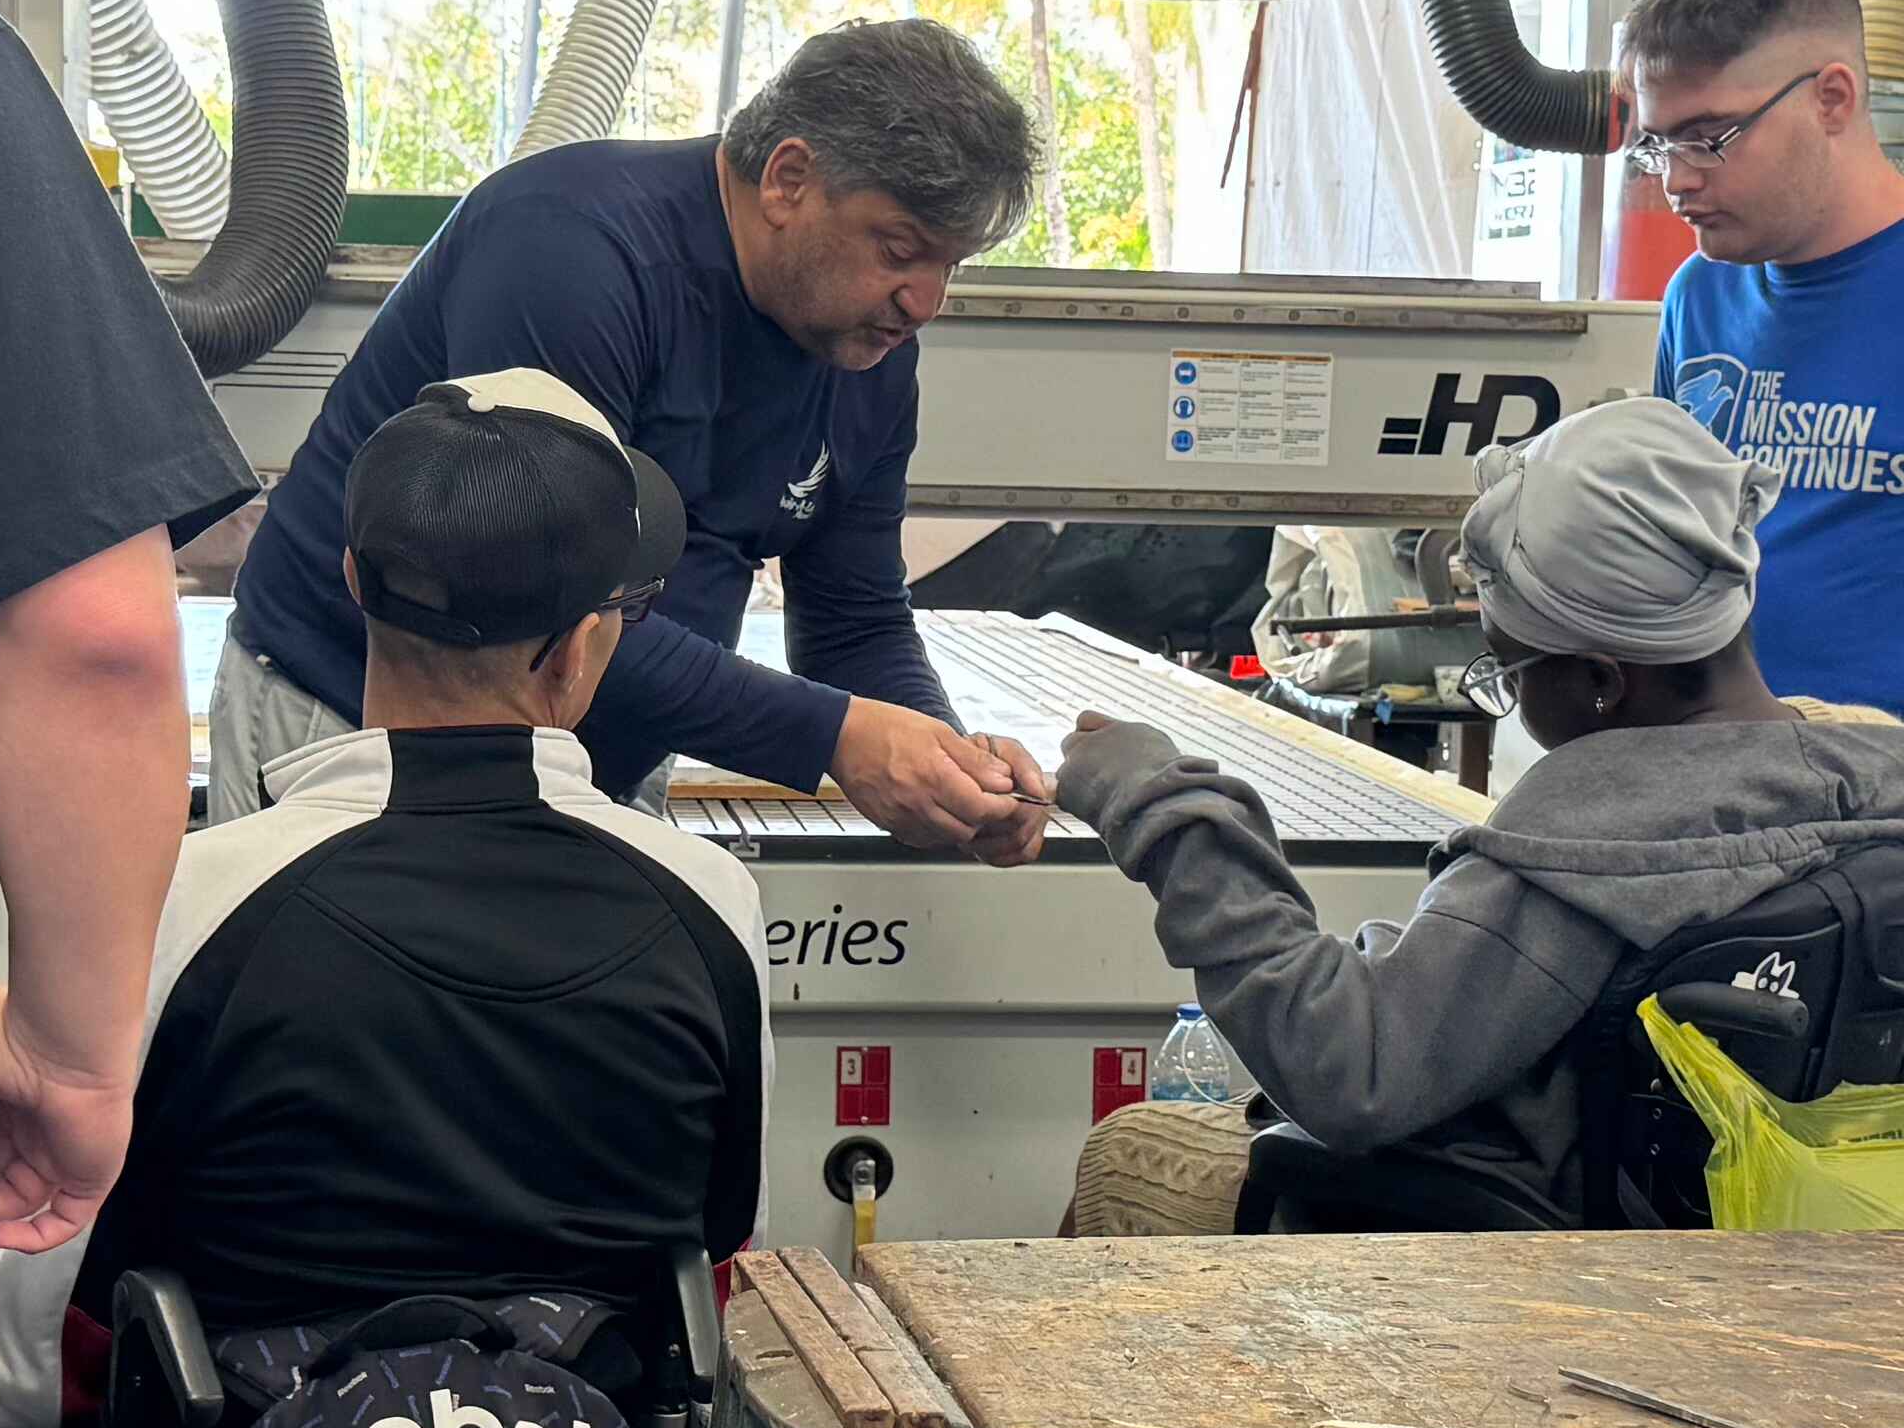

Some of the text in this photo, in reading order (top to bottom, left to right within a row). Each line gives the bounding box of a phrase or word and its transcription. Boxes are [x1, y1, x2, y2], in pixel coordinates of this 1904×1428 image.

[1749, 370, 1785, 401] THE
[1739, 399, 1877, 447] MISSION
[847, 1058, 857, 1075] 3
[1126, 1059, 1136, 1075] 4
